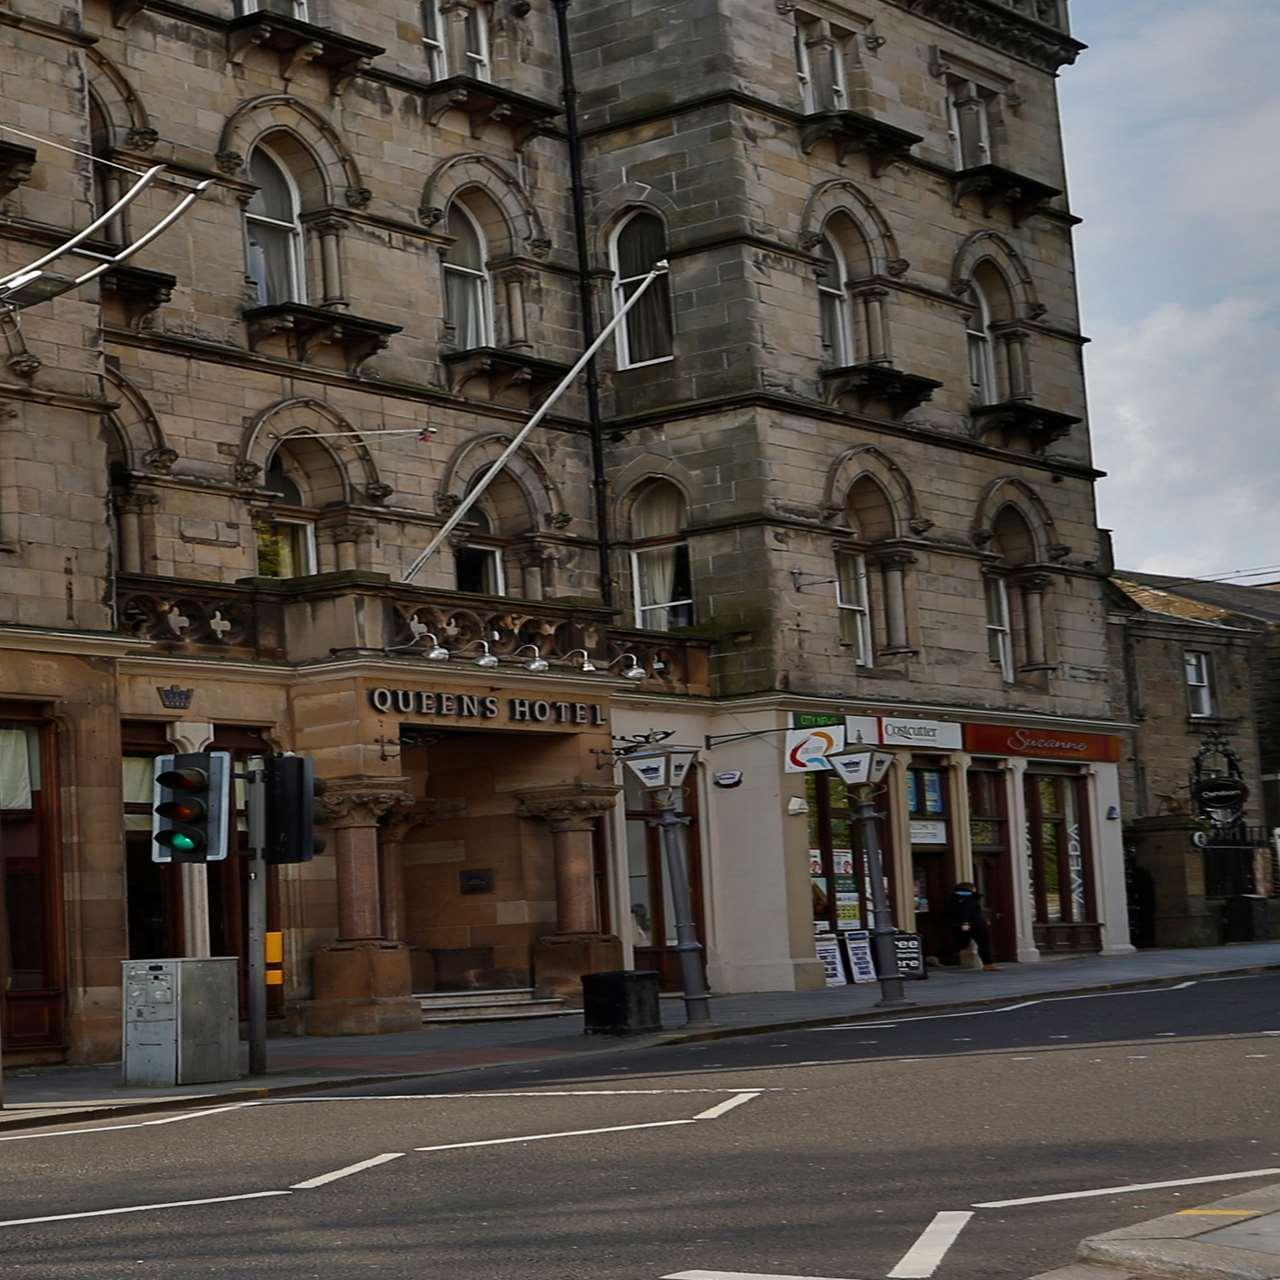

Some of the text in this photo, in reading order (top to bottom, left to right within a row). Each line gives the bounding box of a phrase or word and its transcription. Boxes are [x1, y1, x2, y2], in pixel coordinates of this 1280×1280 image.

[372, 688, 607, 725] QUEENS HOTEL
[884, 723, 937, 738] Costcutter
[1068, 823, 1085, 904] AVEDA
